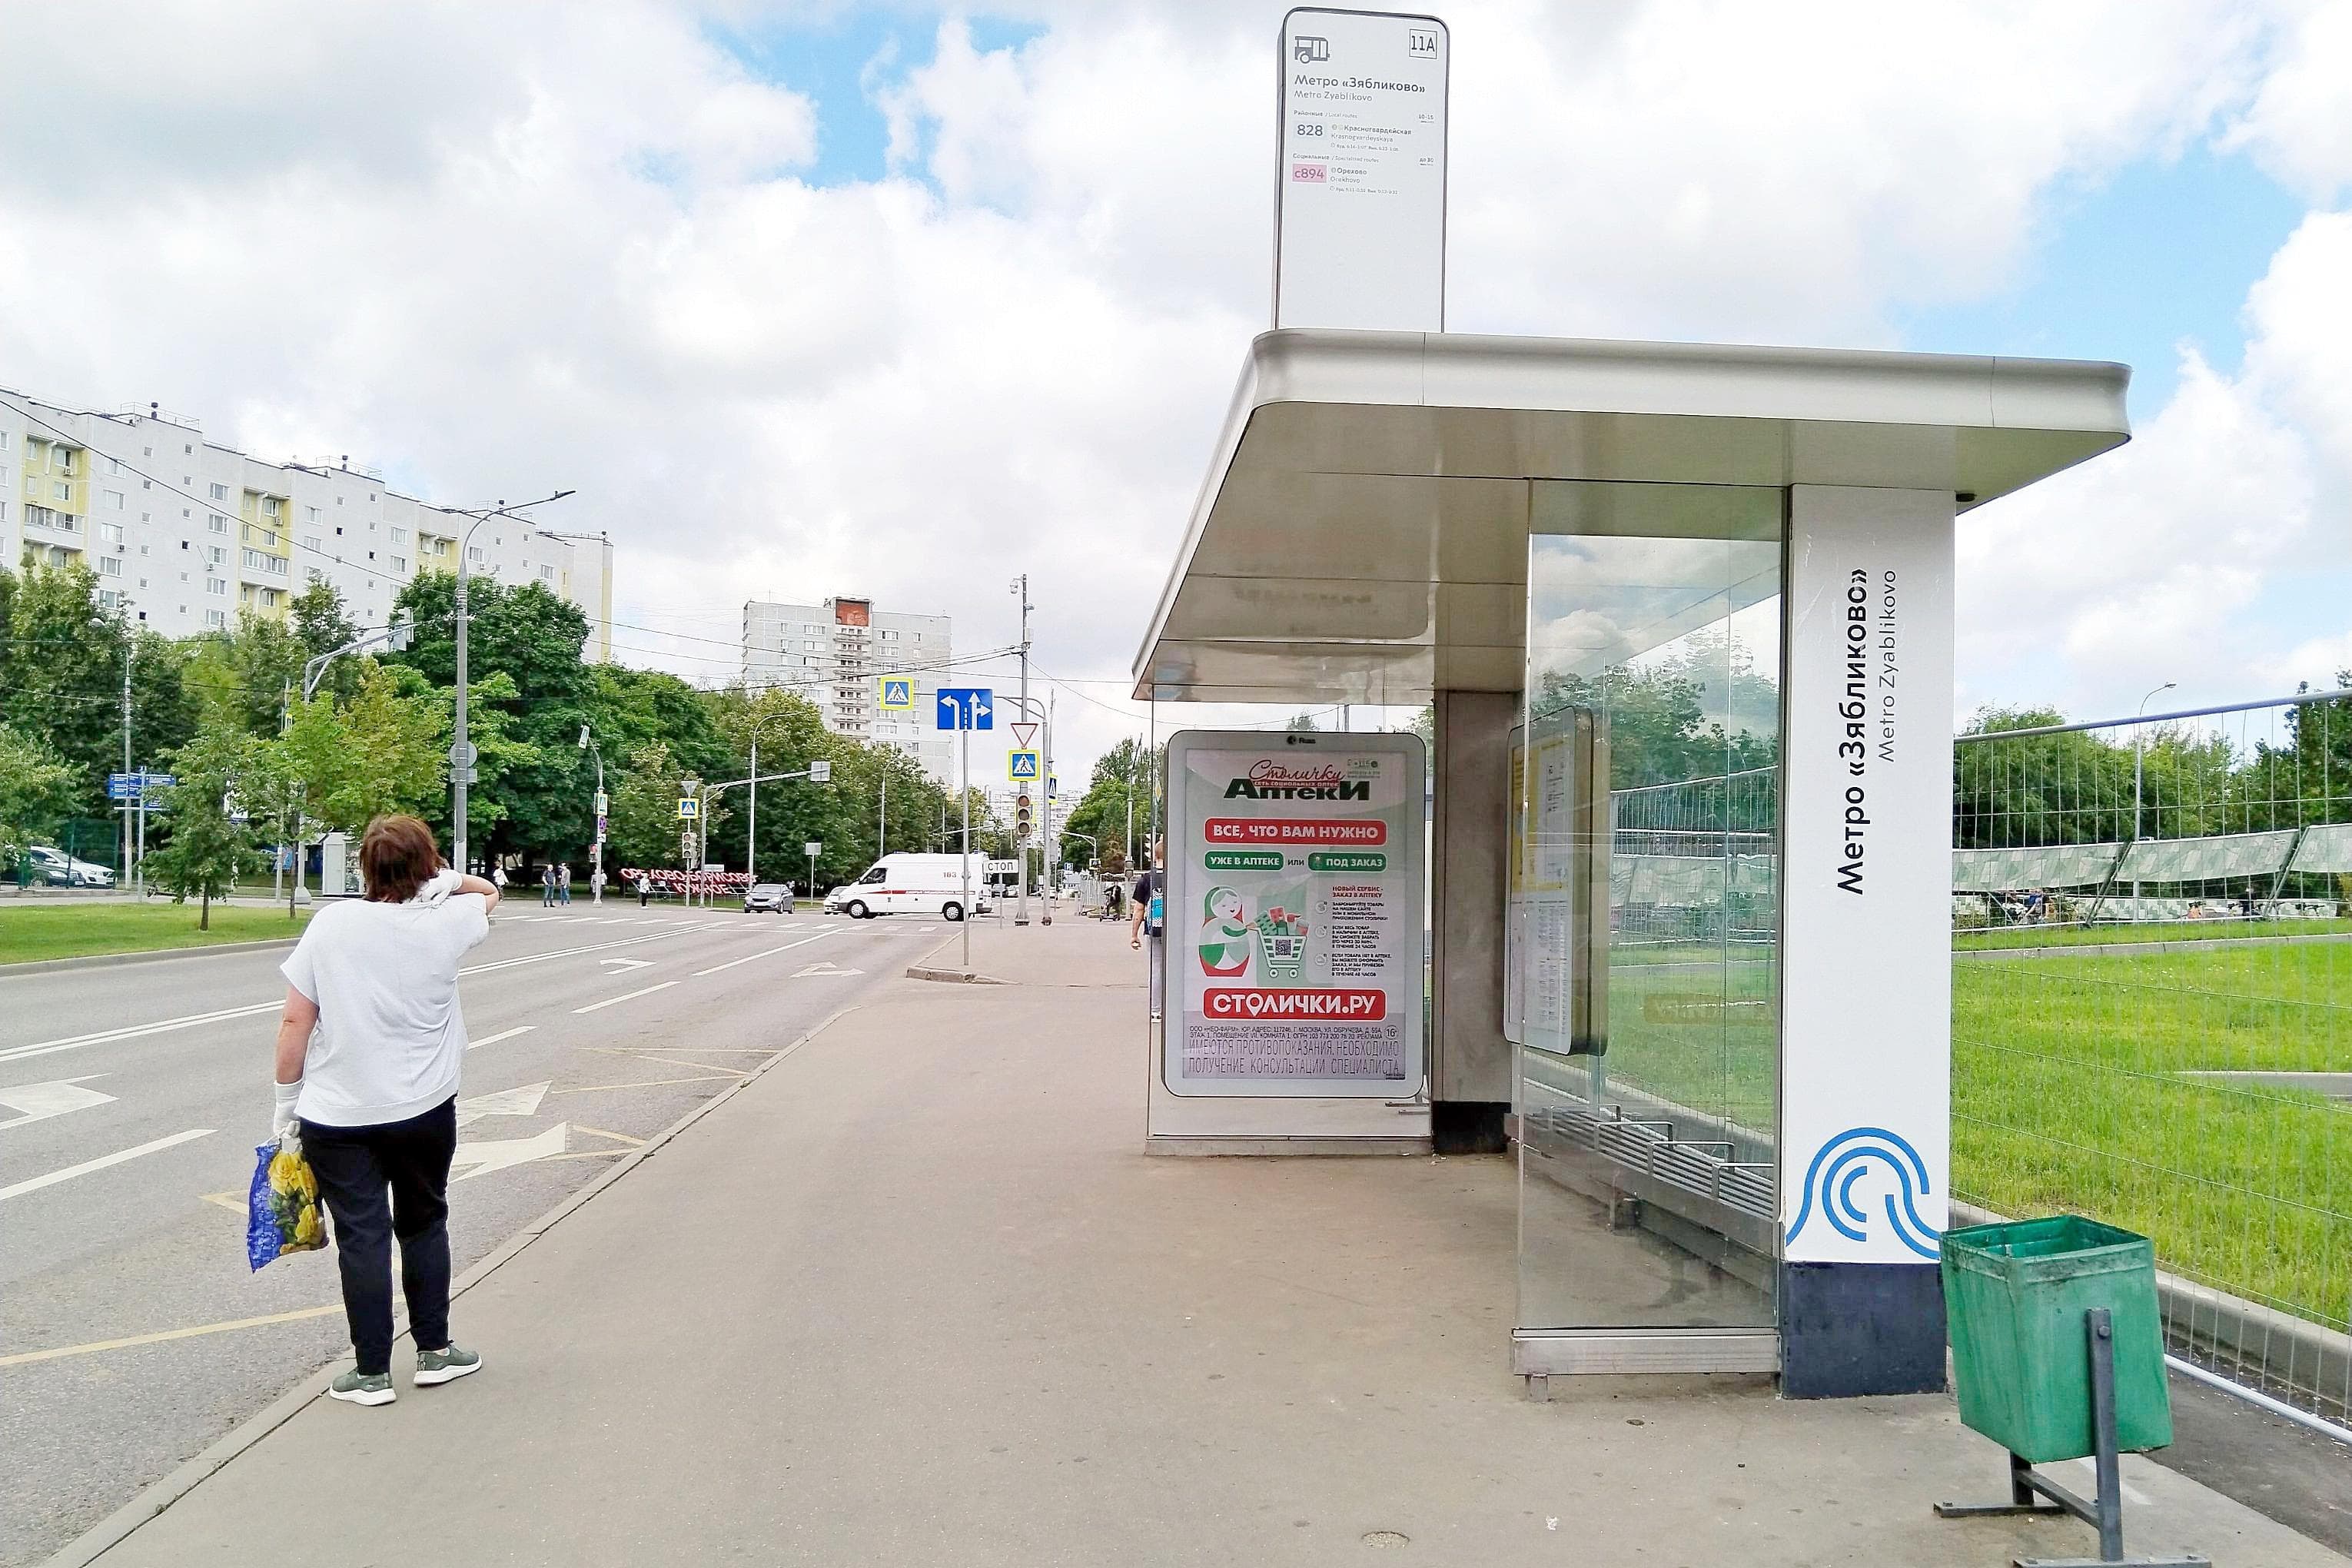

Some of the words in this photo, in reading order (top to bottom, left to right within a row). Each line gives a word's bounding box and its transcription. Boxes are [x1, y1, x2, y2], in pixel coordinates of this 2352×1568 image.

[1294, 75, 1338, 88] Метро
[1342, 77, 1425, 93] «Зябликово»
[1294, 90, 1321, 99] Metro
[1324, 91, 1373, 101] Zyablikovo
[1297, 124, 1323, 136] 828
[1344, 125, 1412, 135] Красногвардейская
[1337, 167, 1367, 175] Орехово
[1879, 570, 1899, 689] Zyablikovo
[1839, 568, 1868, 776] «Зябликово»
[1878, 695, 1895, 762] Metro
[1248, 759, 1345, 781] Столички
[1213, 825, 1244, 838] ВСЕ,
[1249, 826, 1278, 838] ЧТО
[1282, 826, 1315, 838] ВАМ
[1319, 826, 1378, 839] НУЖНО
[1837, 786, 1870, 895] Метро
[988, 862, 1014, 871] СТОП
[1211, 856, 1232, 865] УЖЕ
[1234, 857, 1241, 865] В
[1243, 857, 1280, 866] АПТЕКЕ
[1326, 858, 1349, 868] ПОД
[1350, 858, 1383, 867] ЗАКАЗ
[1213, 993, 1376, 1017] СТОЛИЧКИ.РУ
[1189, 1038, 1234, 1055] ИМЕЮТСЯ
[1337, 1040, 1399, 1056] НЕОБХОДИМО
[1189, 1057, 1245, 1073] ПОЛУЧЕНИЕ
[1251, 1058, 1326, 1075] КОНСУЛЬТАЦИИ
[1330, 1058, 1399, 1075] СПЕЦИАЛИСТА
